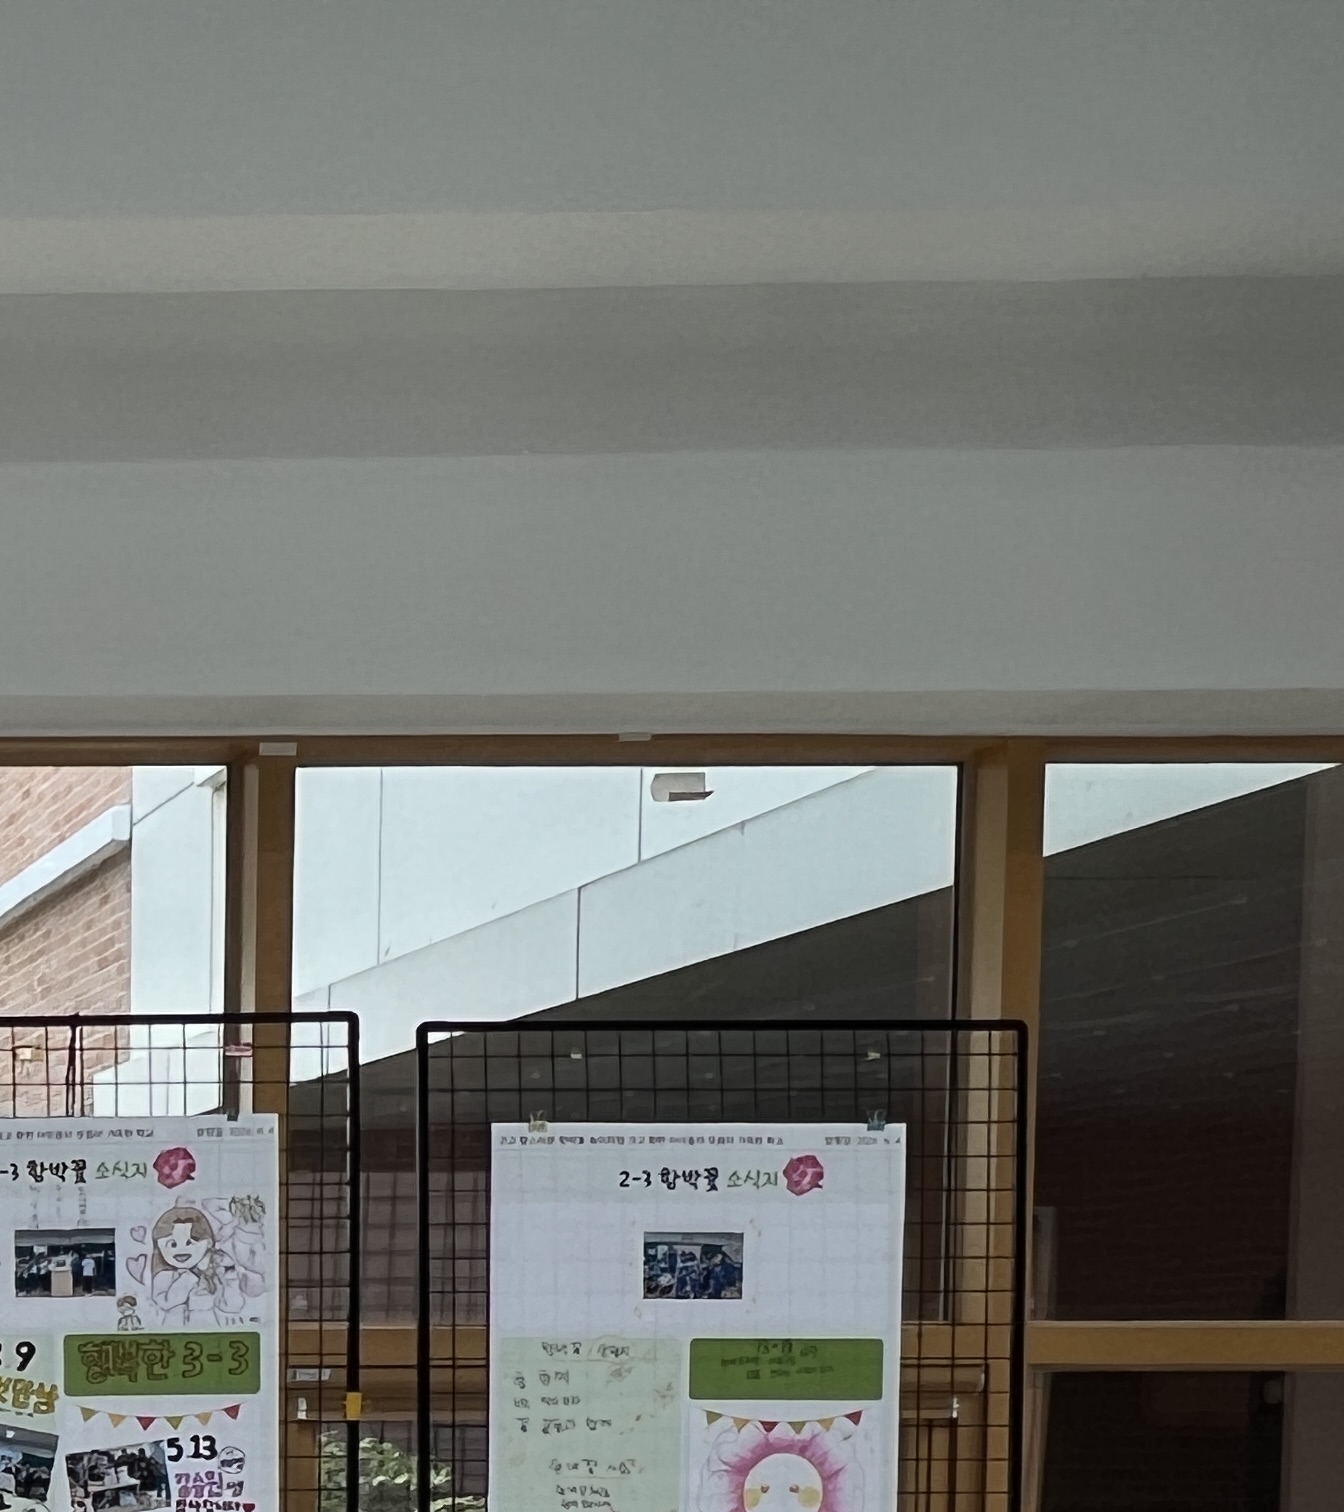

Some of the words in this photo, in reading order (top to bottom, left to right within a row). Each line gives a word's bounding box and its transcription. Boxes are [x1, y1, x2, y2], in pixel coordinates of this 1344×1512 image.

[26, 1158, 87, 1185] 함박꽃
[95, 1160, 148, 1180] 소식지
[618, 1169, 653, 1189] 2-3
[658, 1166, 719, 1193] 함박꽃
[727, 1168, 779, 1189] 소식지
[182, 1339, 250, 1379] 3-3
